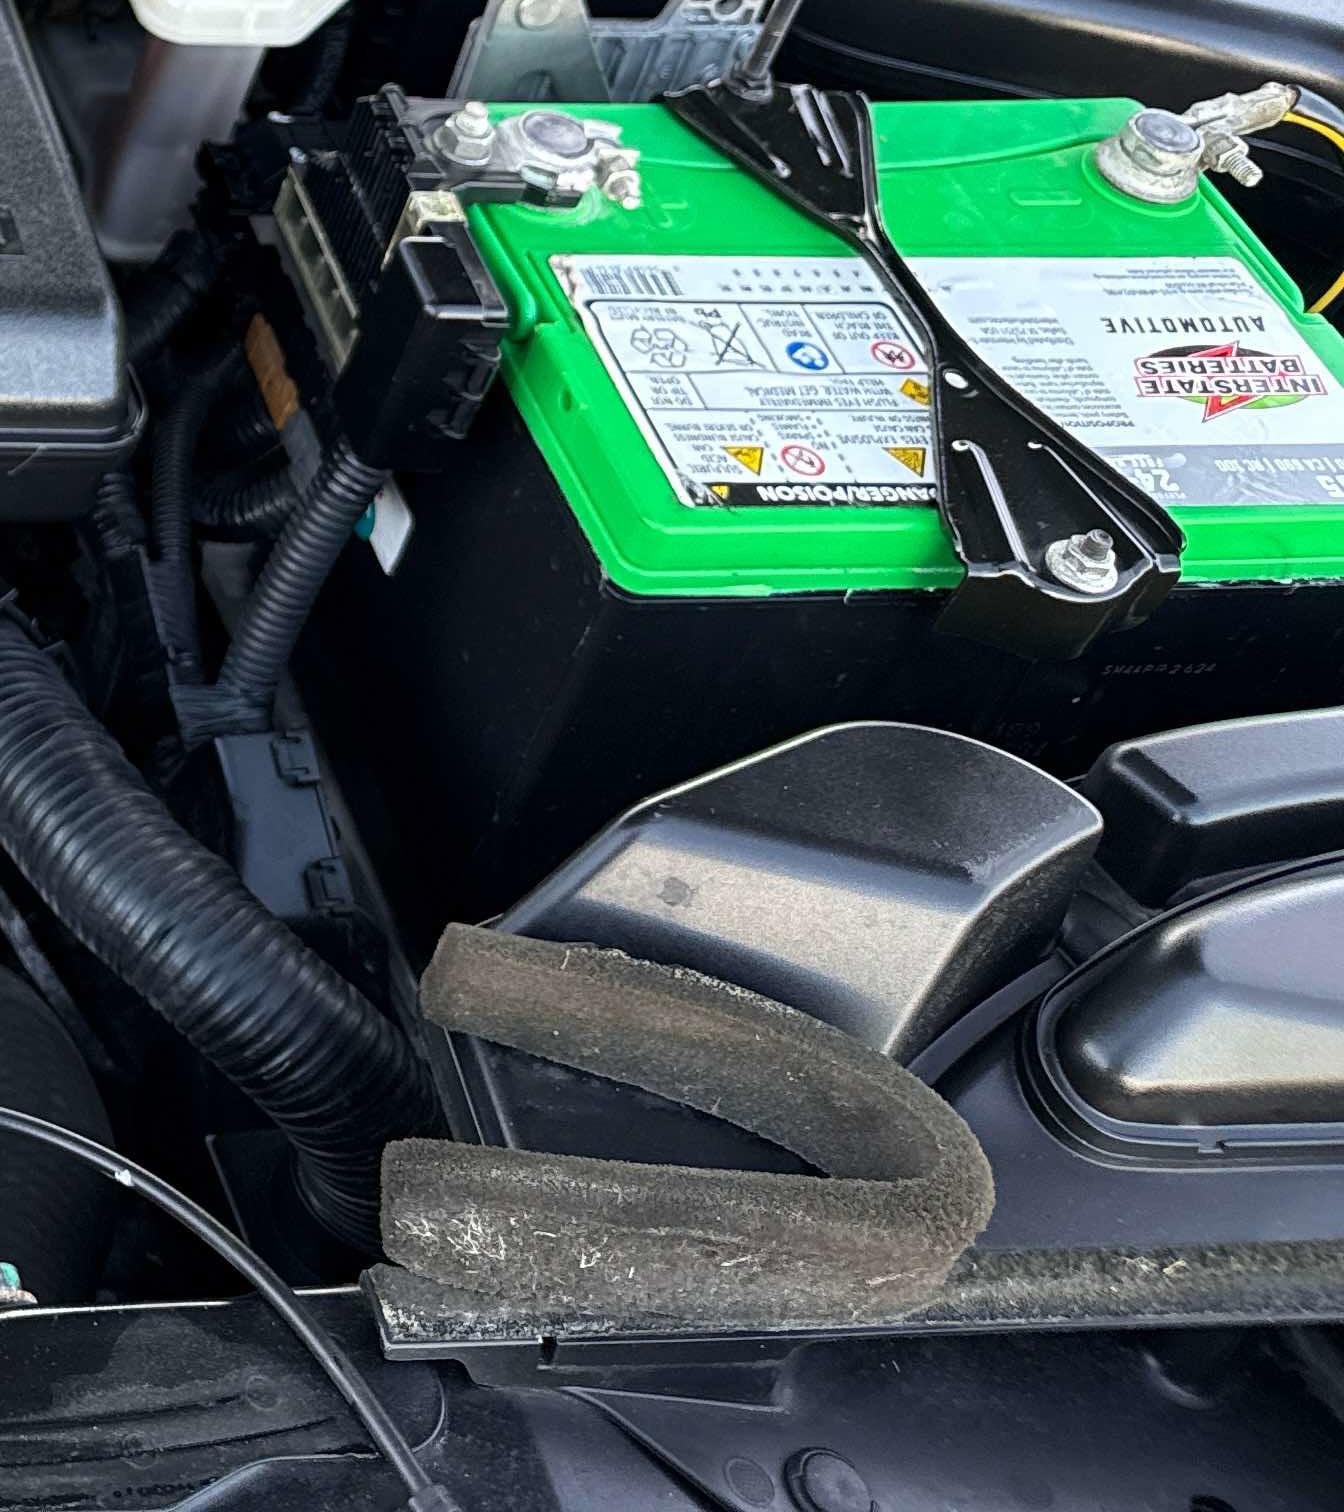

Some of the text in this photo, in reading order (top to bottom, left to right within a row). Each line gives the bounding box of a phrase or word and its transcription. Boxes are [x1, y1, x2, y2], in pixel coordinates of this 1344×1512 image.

[1100, 316, 1265, 333] AUTOMOTIVE
[1140, 358, 1298, 375] BATTERIES
[1139, 378, 1321, 394] INTERSTATE
